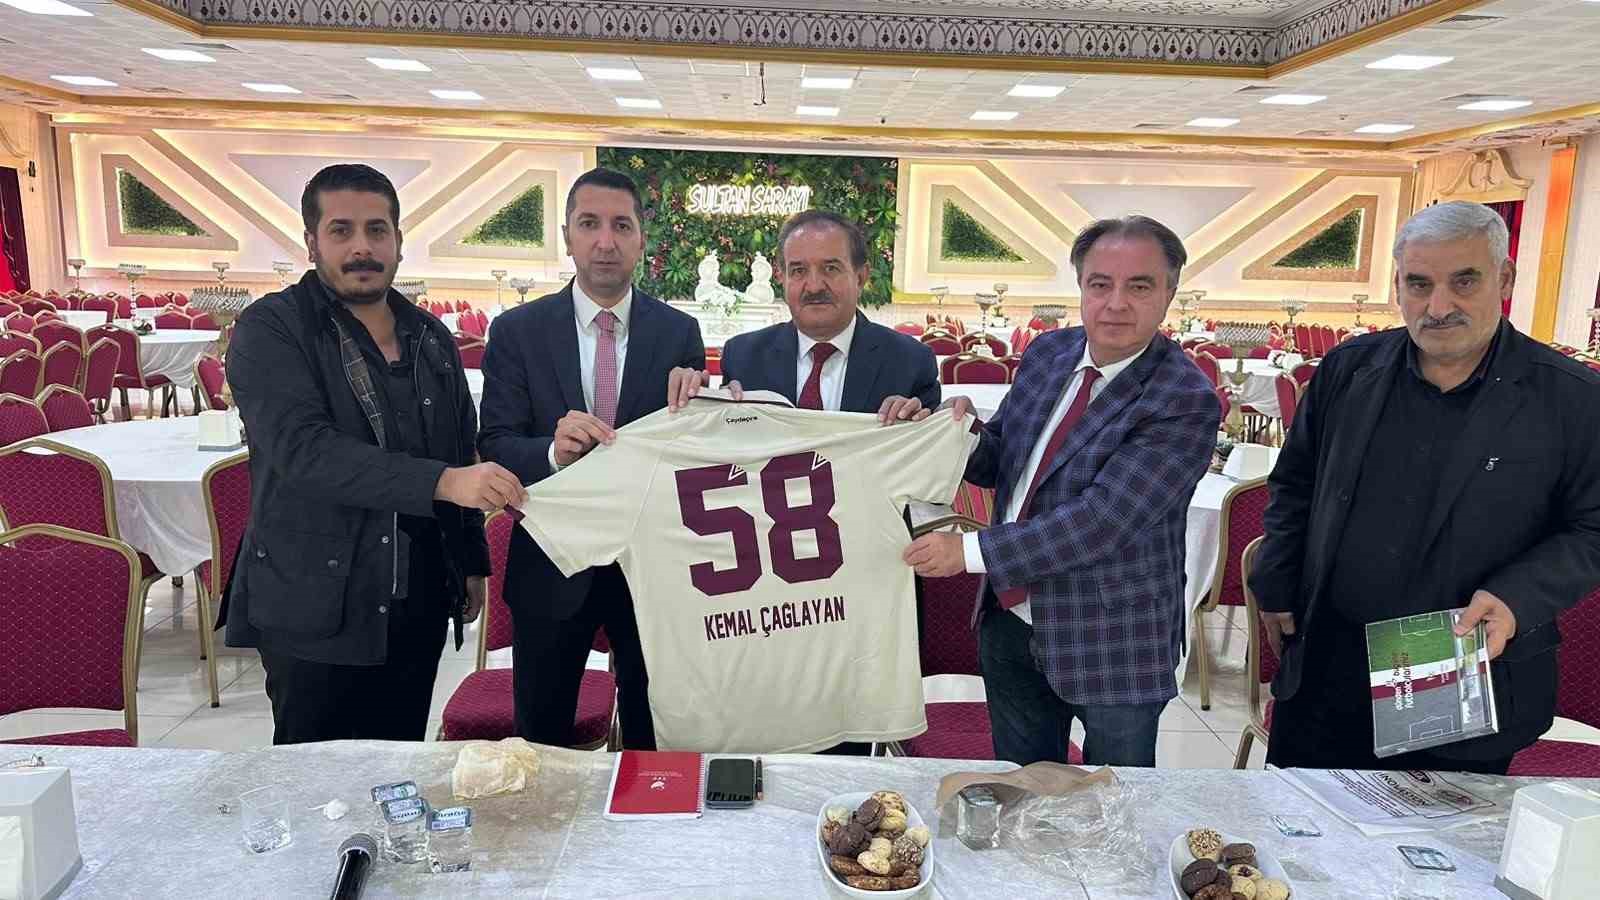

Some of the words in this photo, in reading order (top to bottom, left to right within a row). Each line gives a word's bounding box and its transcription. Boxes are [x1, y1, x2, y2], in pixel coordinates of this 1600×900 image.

[688, 184, 751, 214] SULTAN
[751, 184, 812, 214] SARAYI
[674, 451, 844, 596] 58
[704, 609, 757, 641] KEMAL
